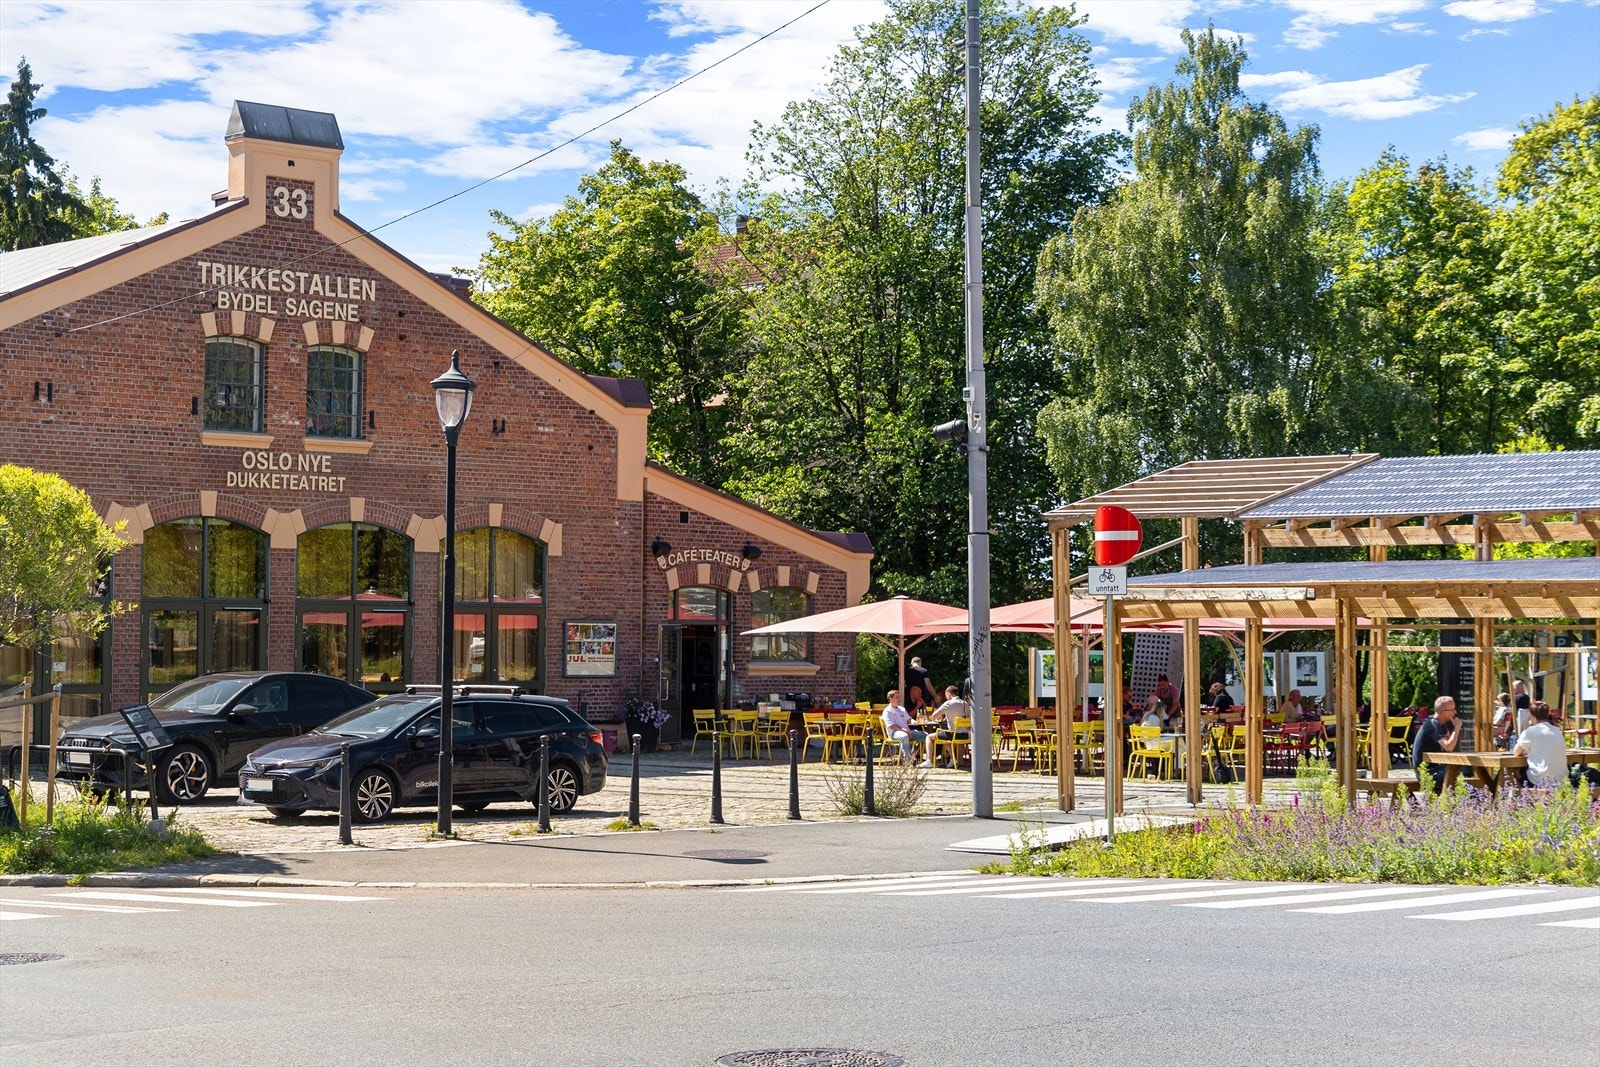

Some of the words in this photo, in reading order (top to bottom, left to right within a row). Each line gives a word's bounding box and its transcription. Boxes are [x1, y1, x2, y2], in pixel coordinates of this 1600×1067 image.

[273, 186, 308, 219] 33
[197, 261, 376, 301] TRIKKESTALLEN
[217, 291, 278, 314] BYDEL
[285, 297, 359, 322] SAGENE
[242, 450, 292, 471] OSLO
[297, 452, 332, 473] NYE
[226, 470, 346, 492] DUKKETEATRET
[668, 546, 698, 566] CAFÉ
[699, 549, 740, 568] TEATER
[567, 655, 587, 663] JUL
